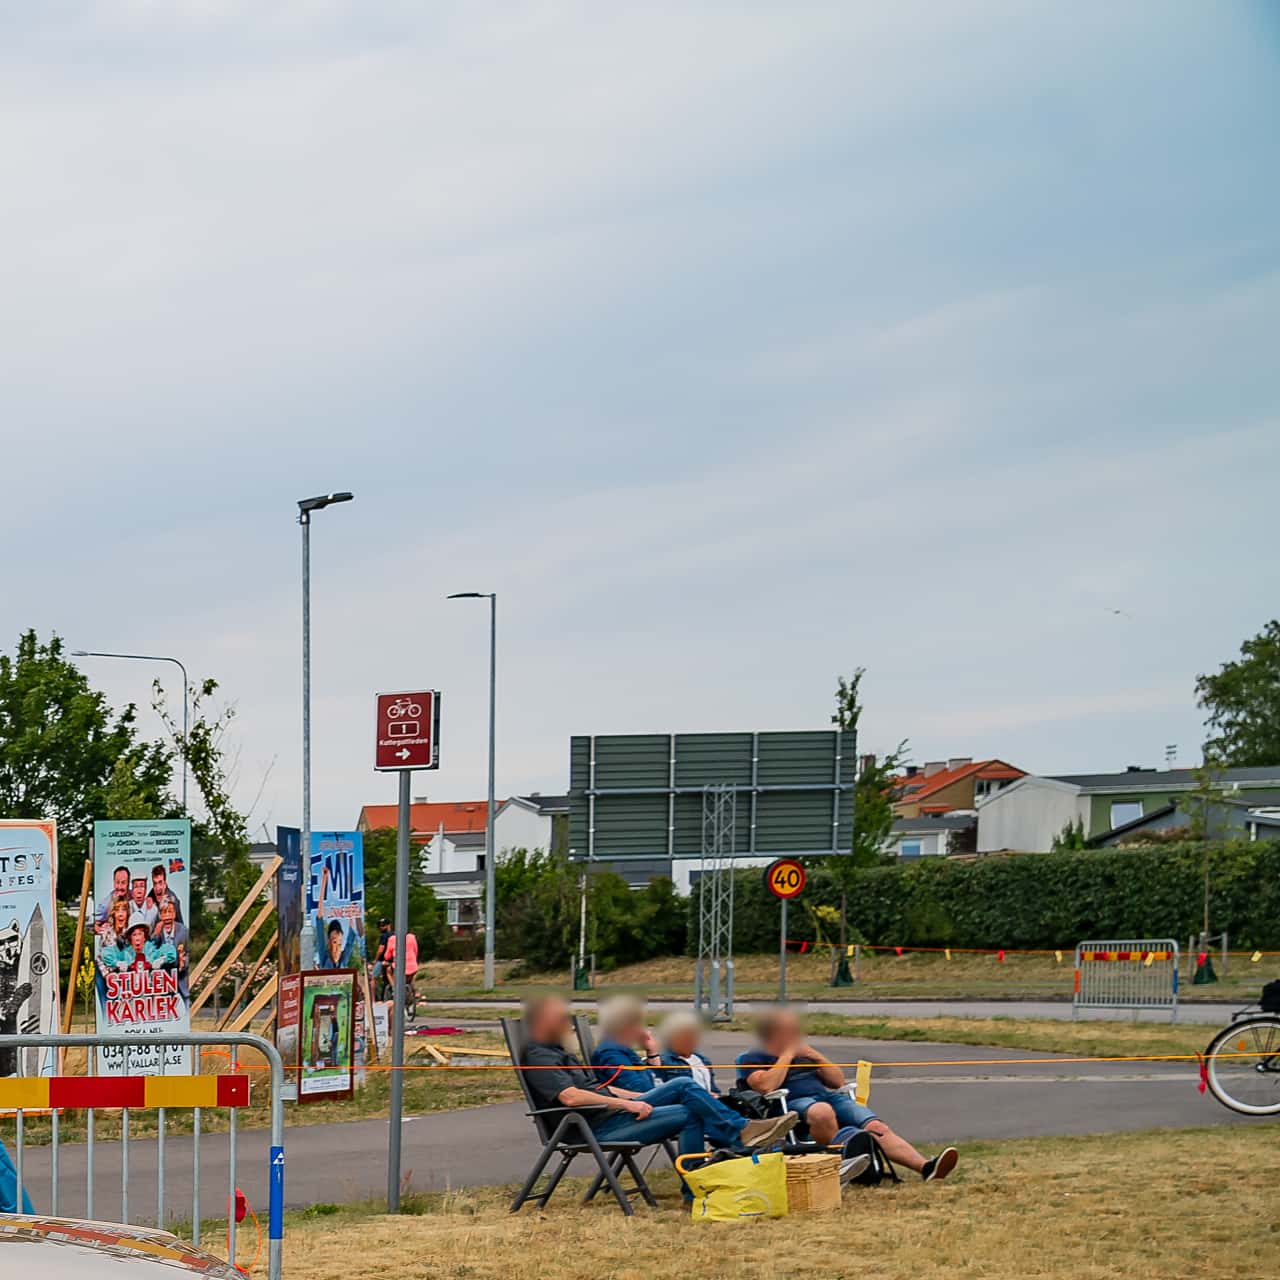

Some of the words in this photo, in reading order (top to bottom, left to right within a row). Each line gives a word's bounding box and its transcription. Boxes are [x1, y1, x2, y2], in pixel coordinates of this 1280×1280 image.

[306, 852, 362, 914] EMIL
[774, 869, 800, 889] 40
[106, 968, 178, 998] STULEN
[106, 992, 179, 1025] KÄRLEK
